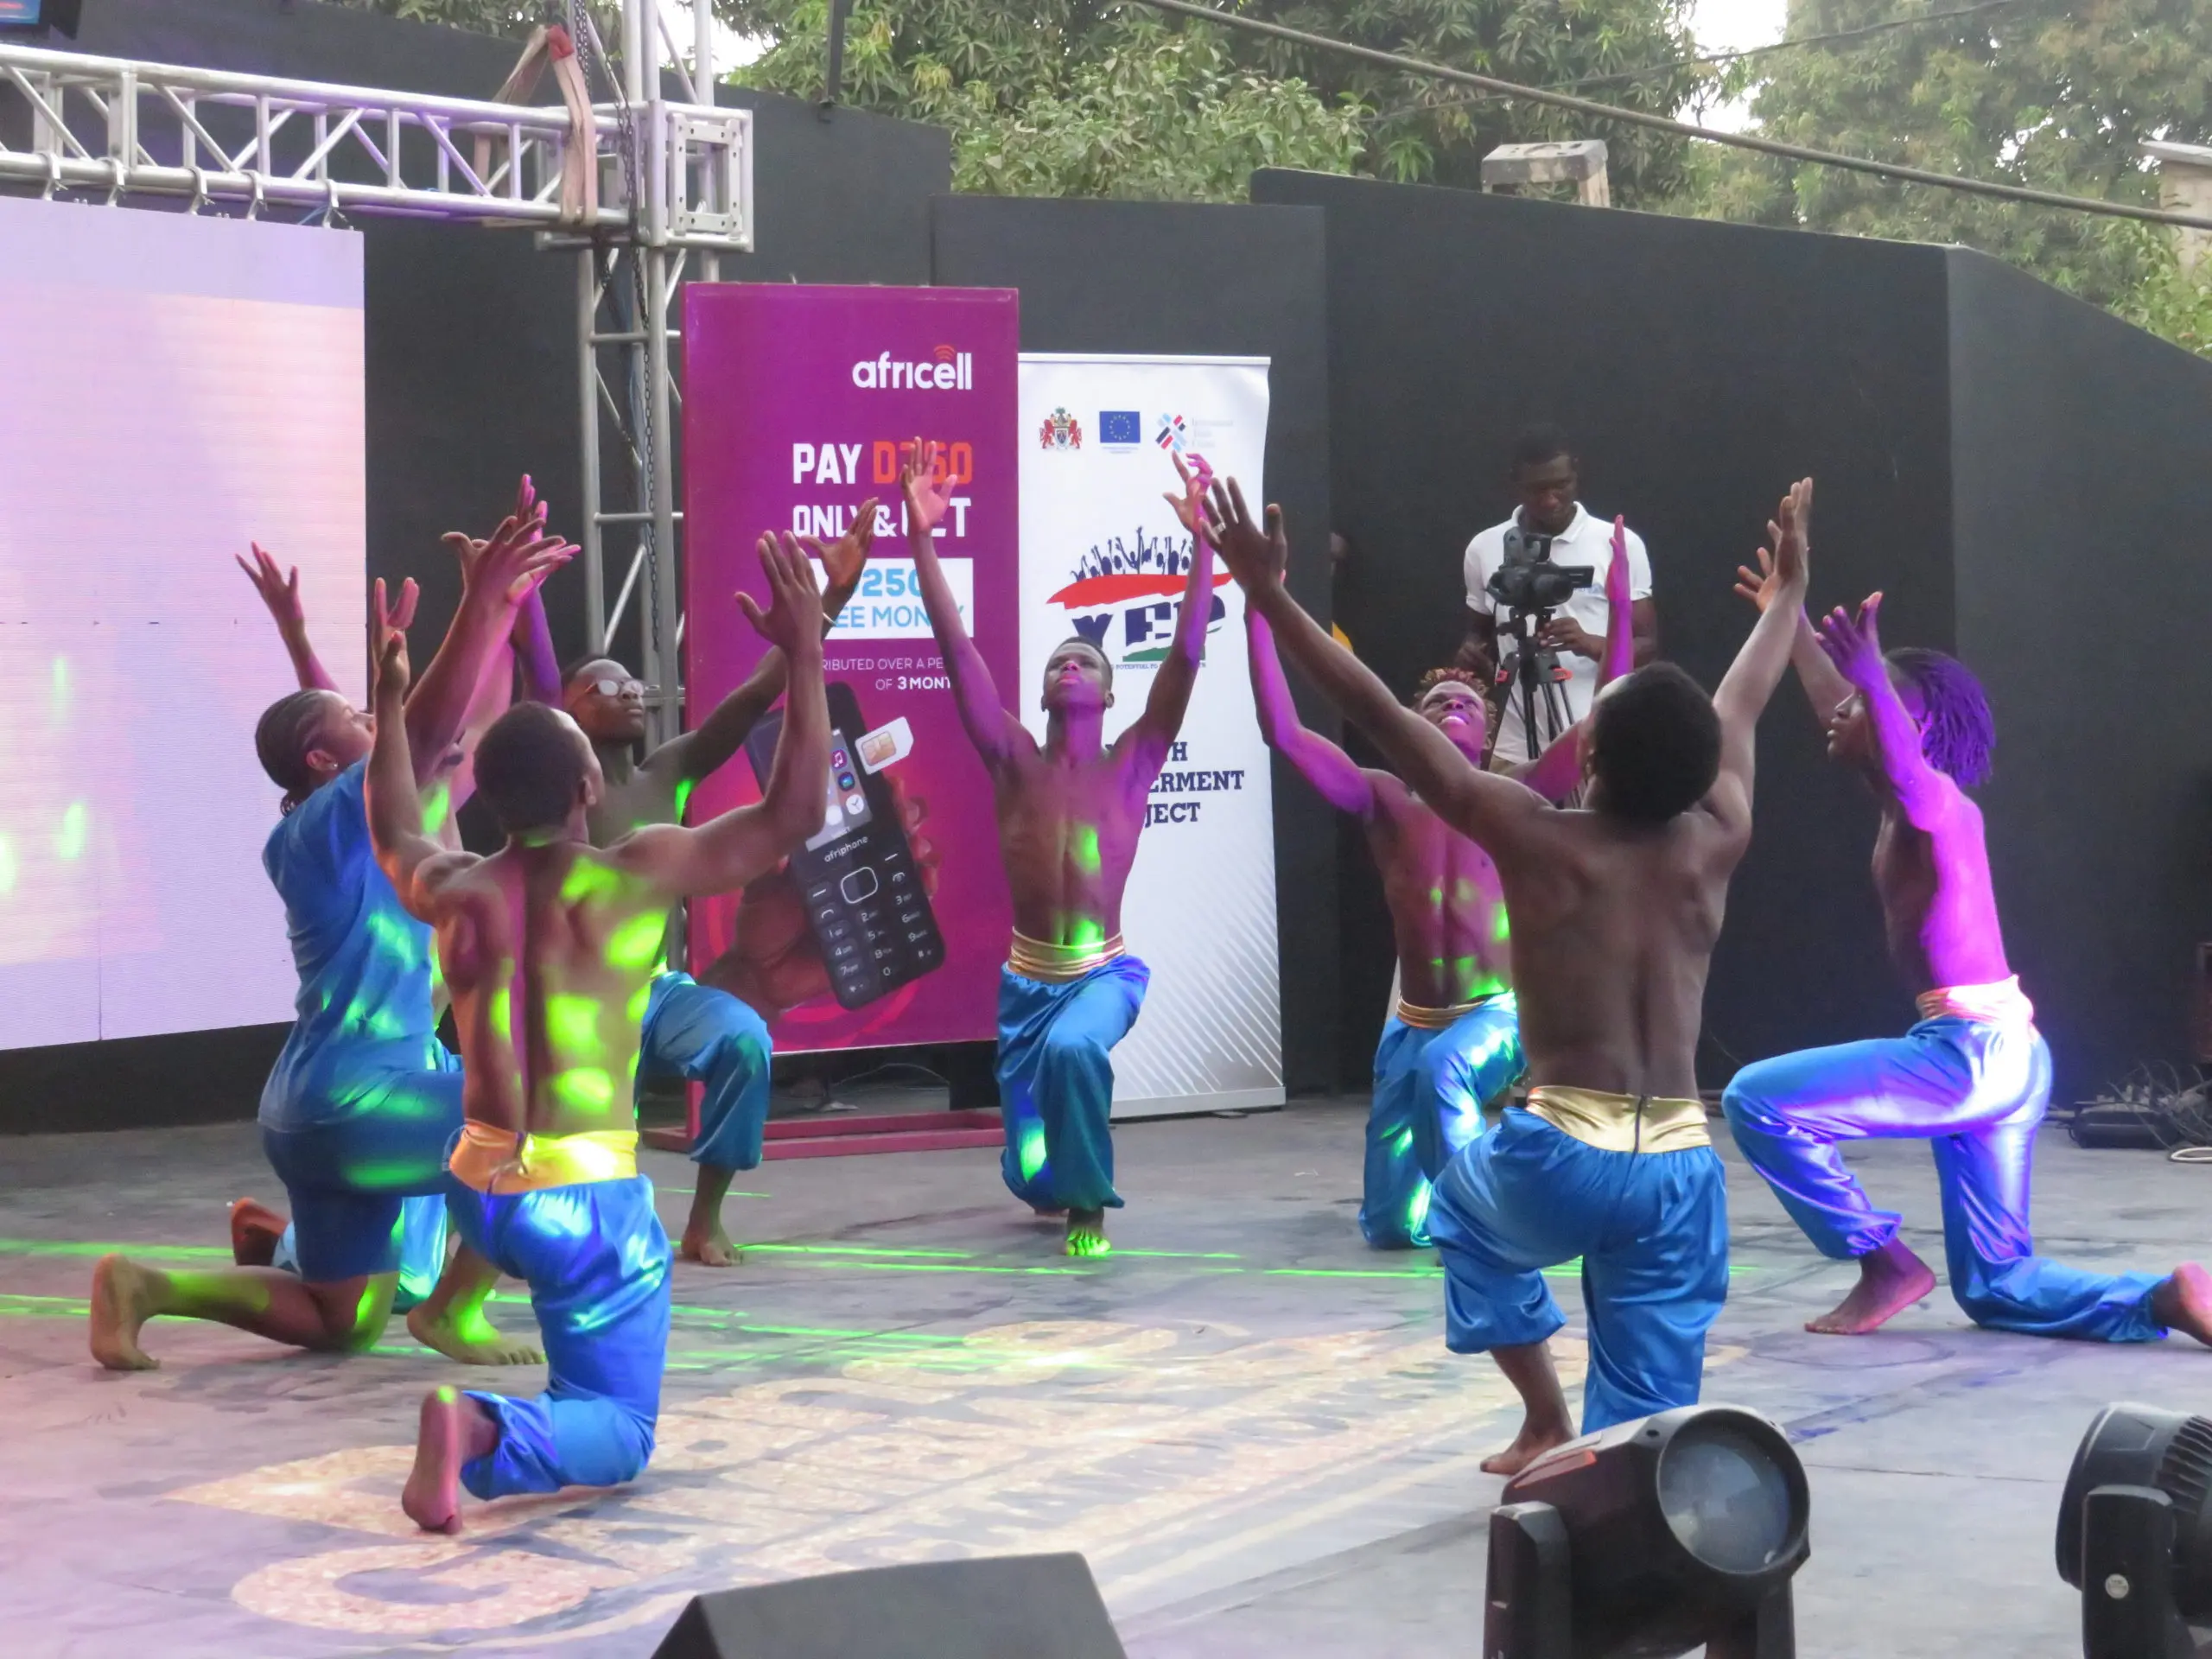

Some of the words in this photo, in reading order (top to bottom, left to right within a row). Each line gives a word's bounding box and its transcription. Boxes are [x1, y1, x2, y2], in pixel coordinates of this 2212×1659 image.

[852, 351, 972, 391] africell
[792, 443, 862, 484] PAY
[873, 505, 898, 537] &
[877, 658, 912, 670] OVER
[916, 658, 925, 669] A
[875, 678, 893, 690] OF
[897, 676, 907, 690] 3
[910, 676, 950, 690] MONT
[823, 836, 868, 862] afriphone
[868, 931, 875, 941] 5
